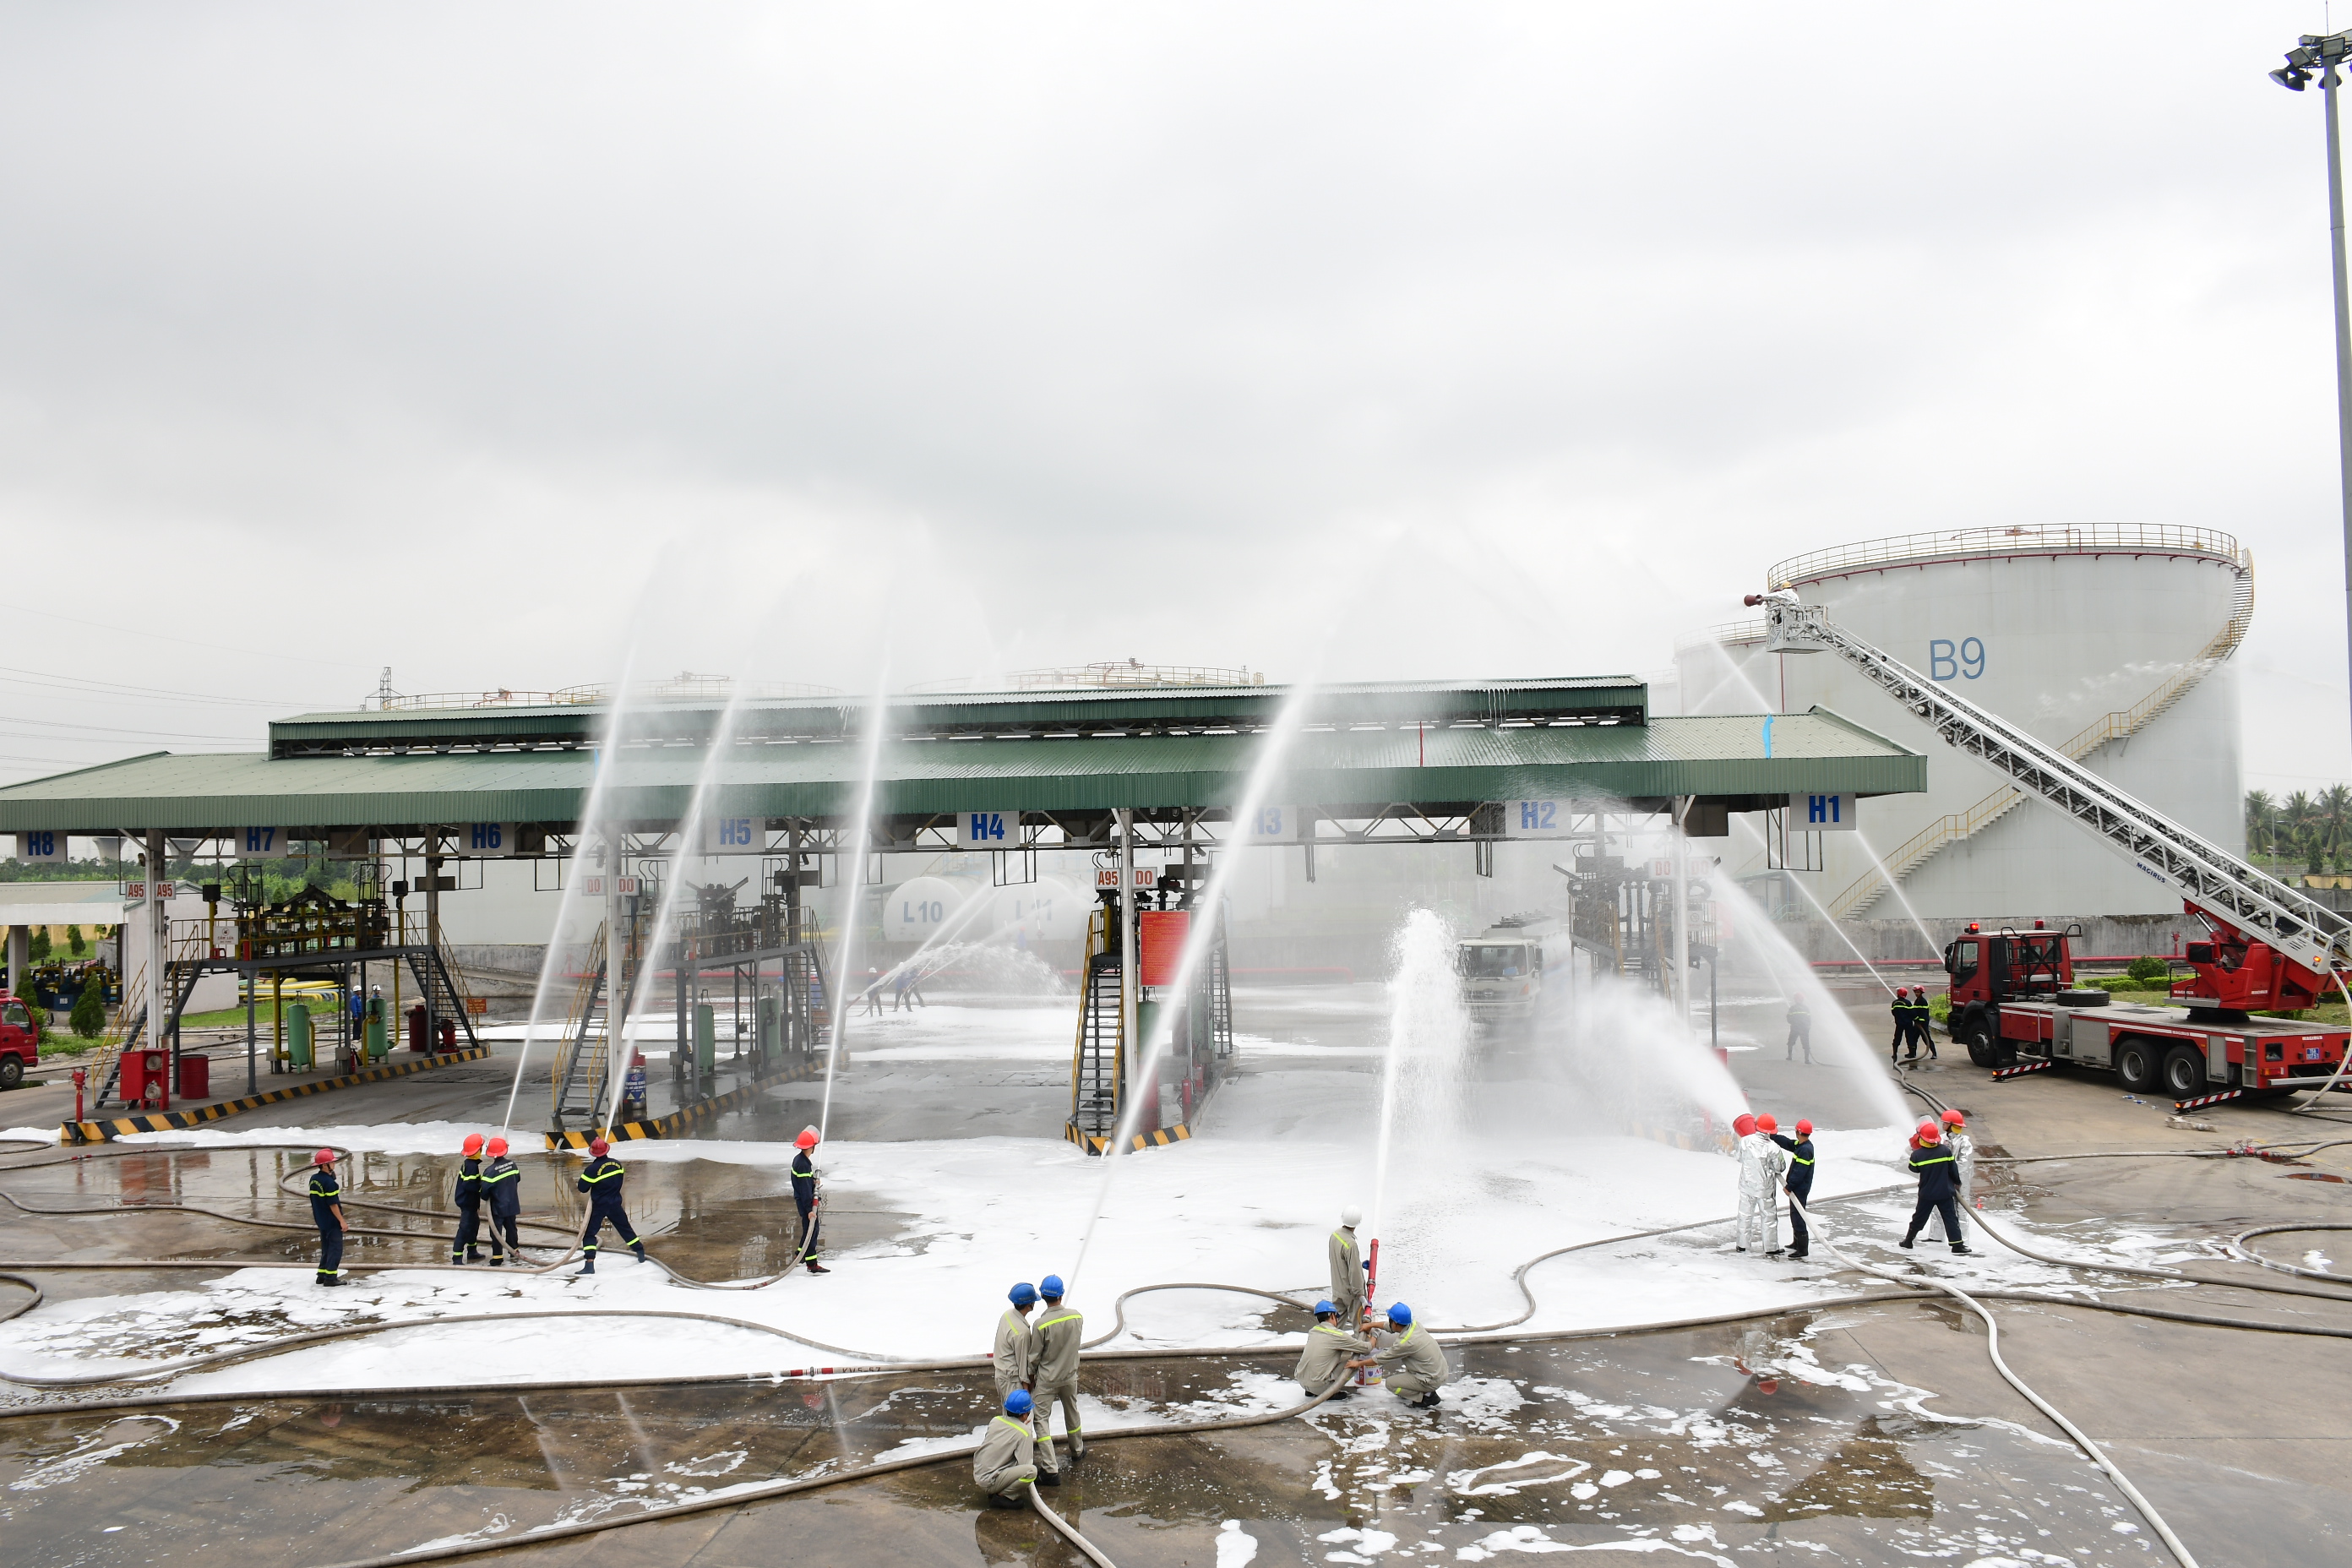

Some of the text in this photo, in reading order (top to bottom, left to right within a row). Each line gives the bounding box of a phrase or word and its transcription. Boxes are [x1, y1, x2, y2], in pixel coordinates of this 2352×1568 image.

[1930, 636, 1985, 681] B9
[1522, 802, 1556, 829] H2
[1809, 796, 1839, 823] H1
[247, 826, 275, 851] H7
[471, 824, 502, 848] H6
[720, 819, 751, 845] H5
[972, 814, 1004, 840] H4
[27, 831, 54, 856] H8
[619, 878, 634, 892] DO
[1097, 870, 1119, 885] A95
[1135, 870, 1153, 885] DO
[2136, 862, 2166, 884] MAGIRUS
[128, 884, 144, 897] A95
[156, 884, 173, 897] A95
[587, 879, 601, 892] DO
